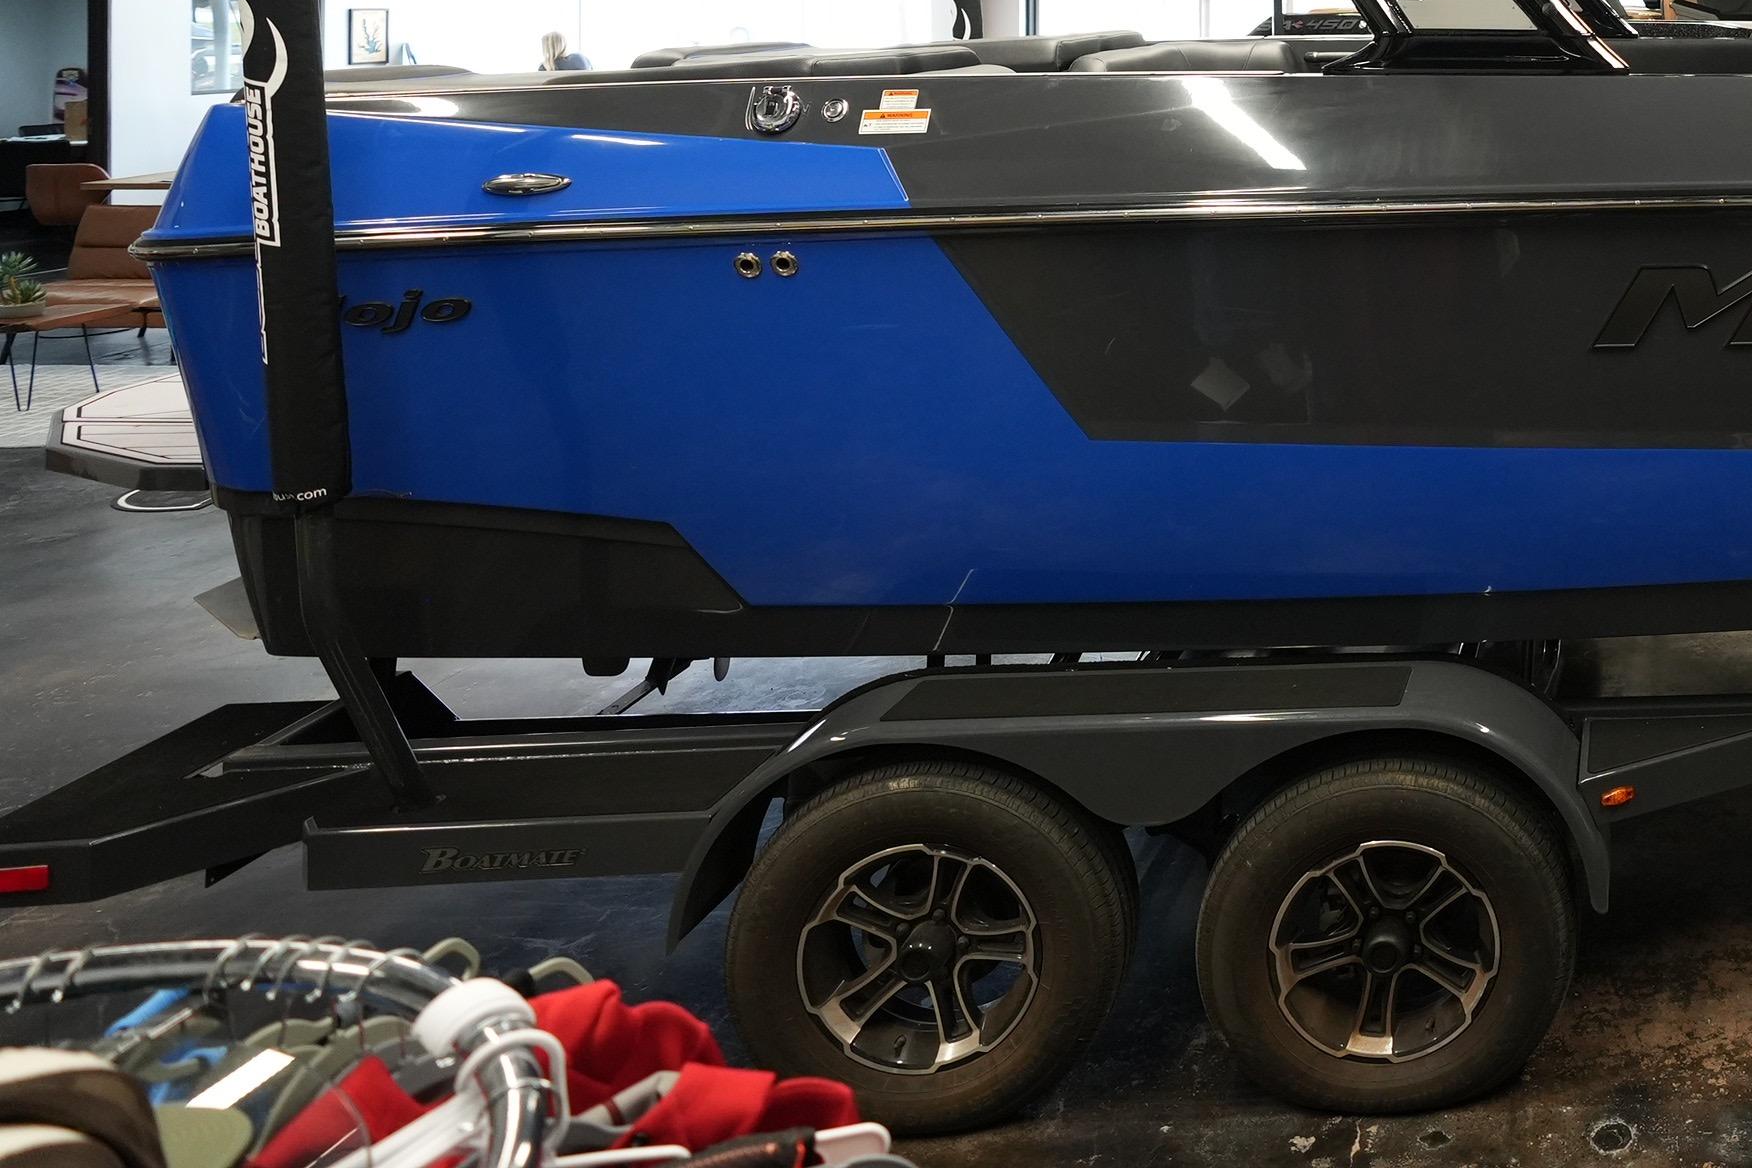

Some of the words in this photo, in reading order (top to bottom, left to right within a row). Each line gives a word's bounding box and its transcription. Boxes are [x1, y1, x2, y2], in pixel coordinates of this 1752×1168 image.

[245, 85, 271, 239] BOATHOUSE
[336, 288, 473, 335] ojo
[417, 845, 582, 876] BOATMATE
